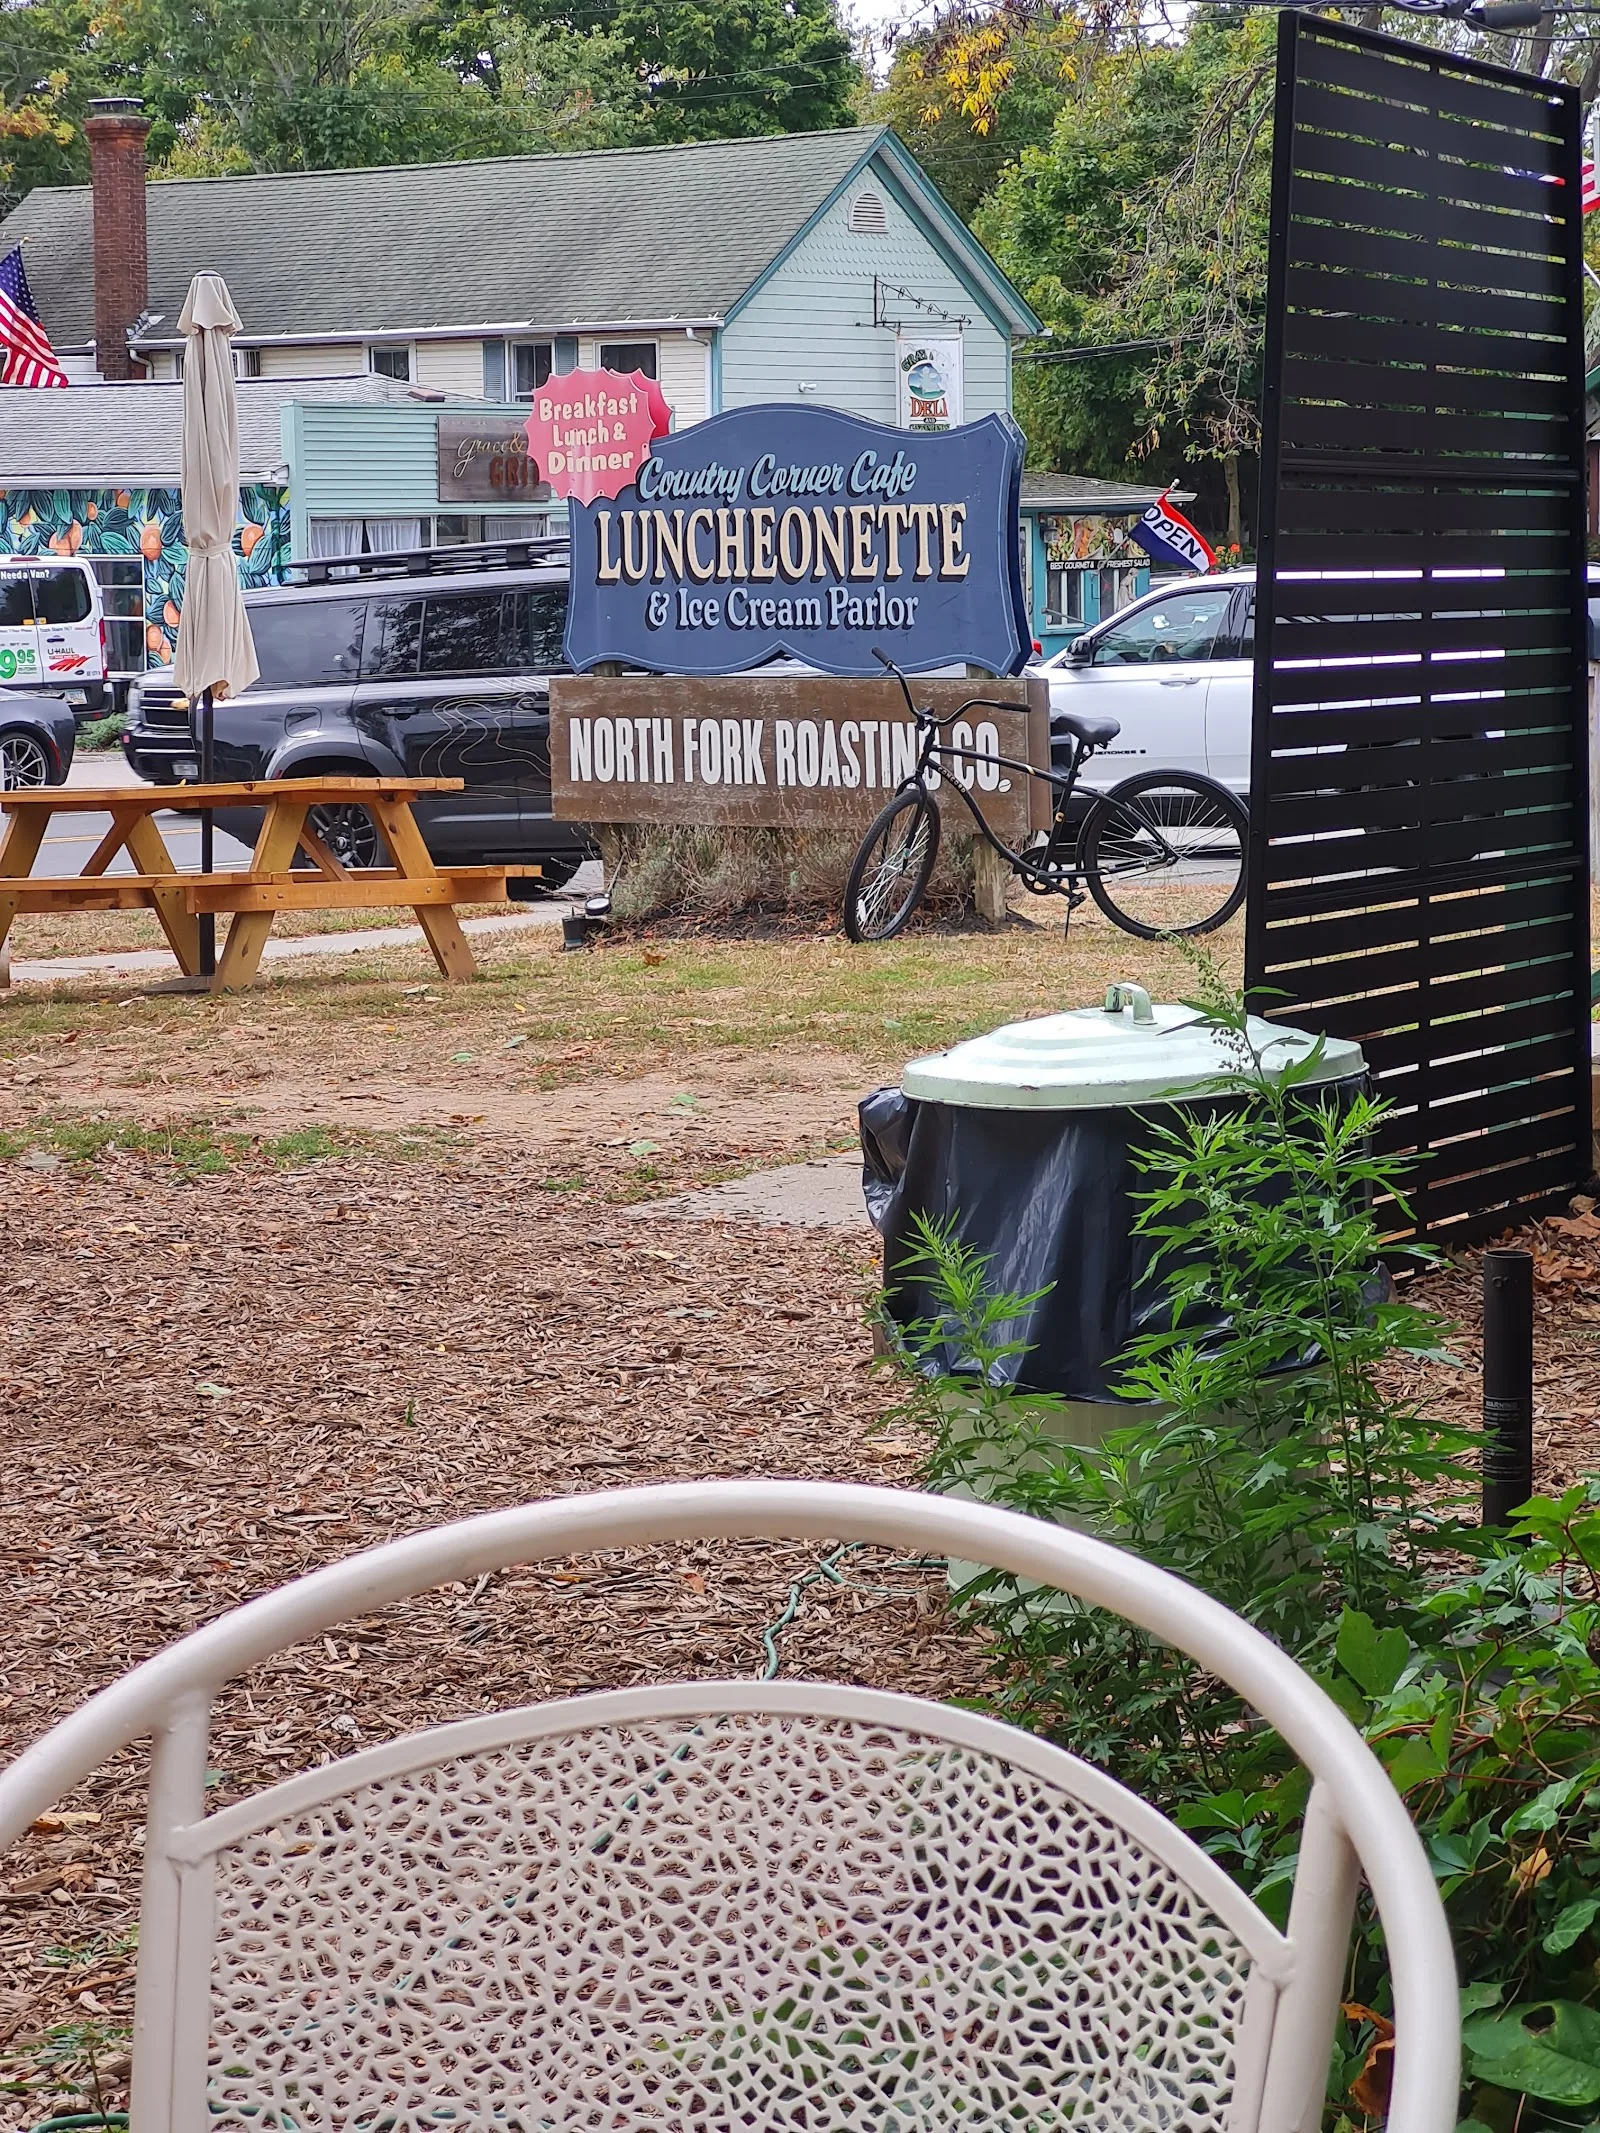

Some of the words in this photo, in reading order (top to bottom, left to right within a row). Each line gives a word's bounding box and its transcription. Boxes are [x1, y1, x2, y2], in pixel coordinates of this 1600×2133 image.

[539, 391, 638, 422] Breakfast
[909, 396, 949, 417] DELI
[553, 419, 609, 448] Lunch
[612, 421, 627, 441] &
[548, 451, 634, 475] Dinner
[639, 456, 745, 503] Country
[750, 453, 844, 497] Corner
[850, 450, 918, 498] Cafe
[597, 502, 972, 580] LUNCHEONETTE
[1143, 506, 1202, 559] OPEN
[0, 570, 22, 580] Need
[22, 571, 28, 579] a
[30, 569, 50, 579] Van?
[1050, 561, 1064, 570] BEST
[648, 591, 670, 627] &
[679, 587, 720, 627] Ice
[727, 587, 822, 627] Cream
[828, 585, 919, 626] Parlor
[569, 717, 674, 783] NORTH
[683, 718, 767, 785] FORK
[952, 720, 1013, 793] CO.
[937, 766, 967, 793] CONCORD
